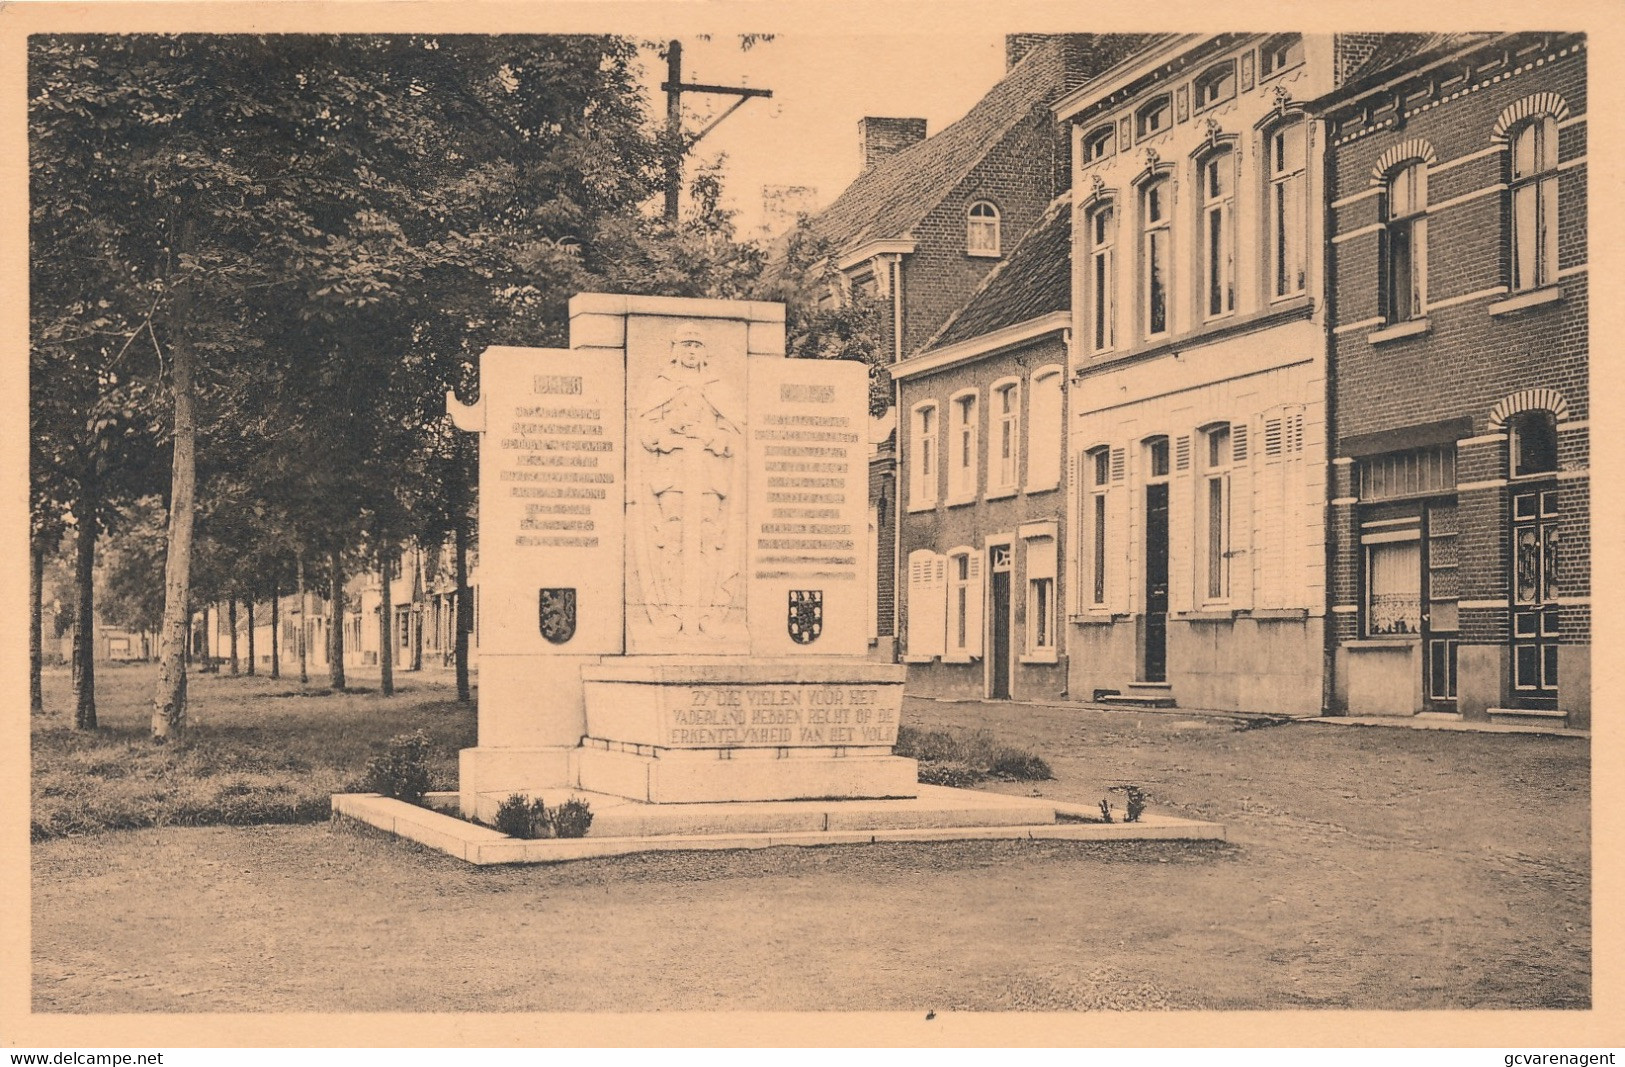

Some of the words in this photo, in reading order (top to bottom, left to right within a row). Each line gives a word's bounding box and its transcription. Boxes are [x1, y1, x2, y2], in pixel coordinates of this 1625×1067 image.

[717, 690, 741, 706] DIE
[746, 690, 801, 706] VIELEN
[807, 690, 843, 705] VOOR
[849, 689, 877, 705] HET
[672, 709, 746, 725] VADERLAND
[751, 708, 804, 724] HEBBEN
[808, 708, 850, 724] RECHT
[856, 708, 873, 724] OP
[878, 708, 895, 724] DE
[799, 727, 826, 743] VAN
[830, 727, 855, 742] HET
[861, 726, 896, 742] VOLK
